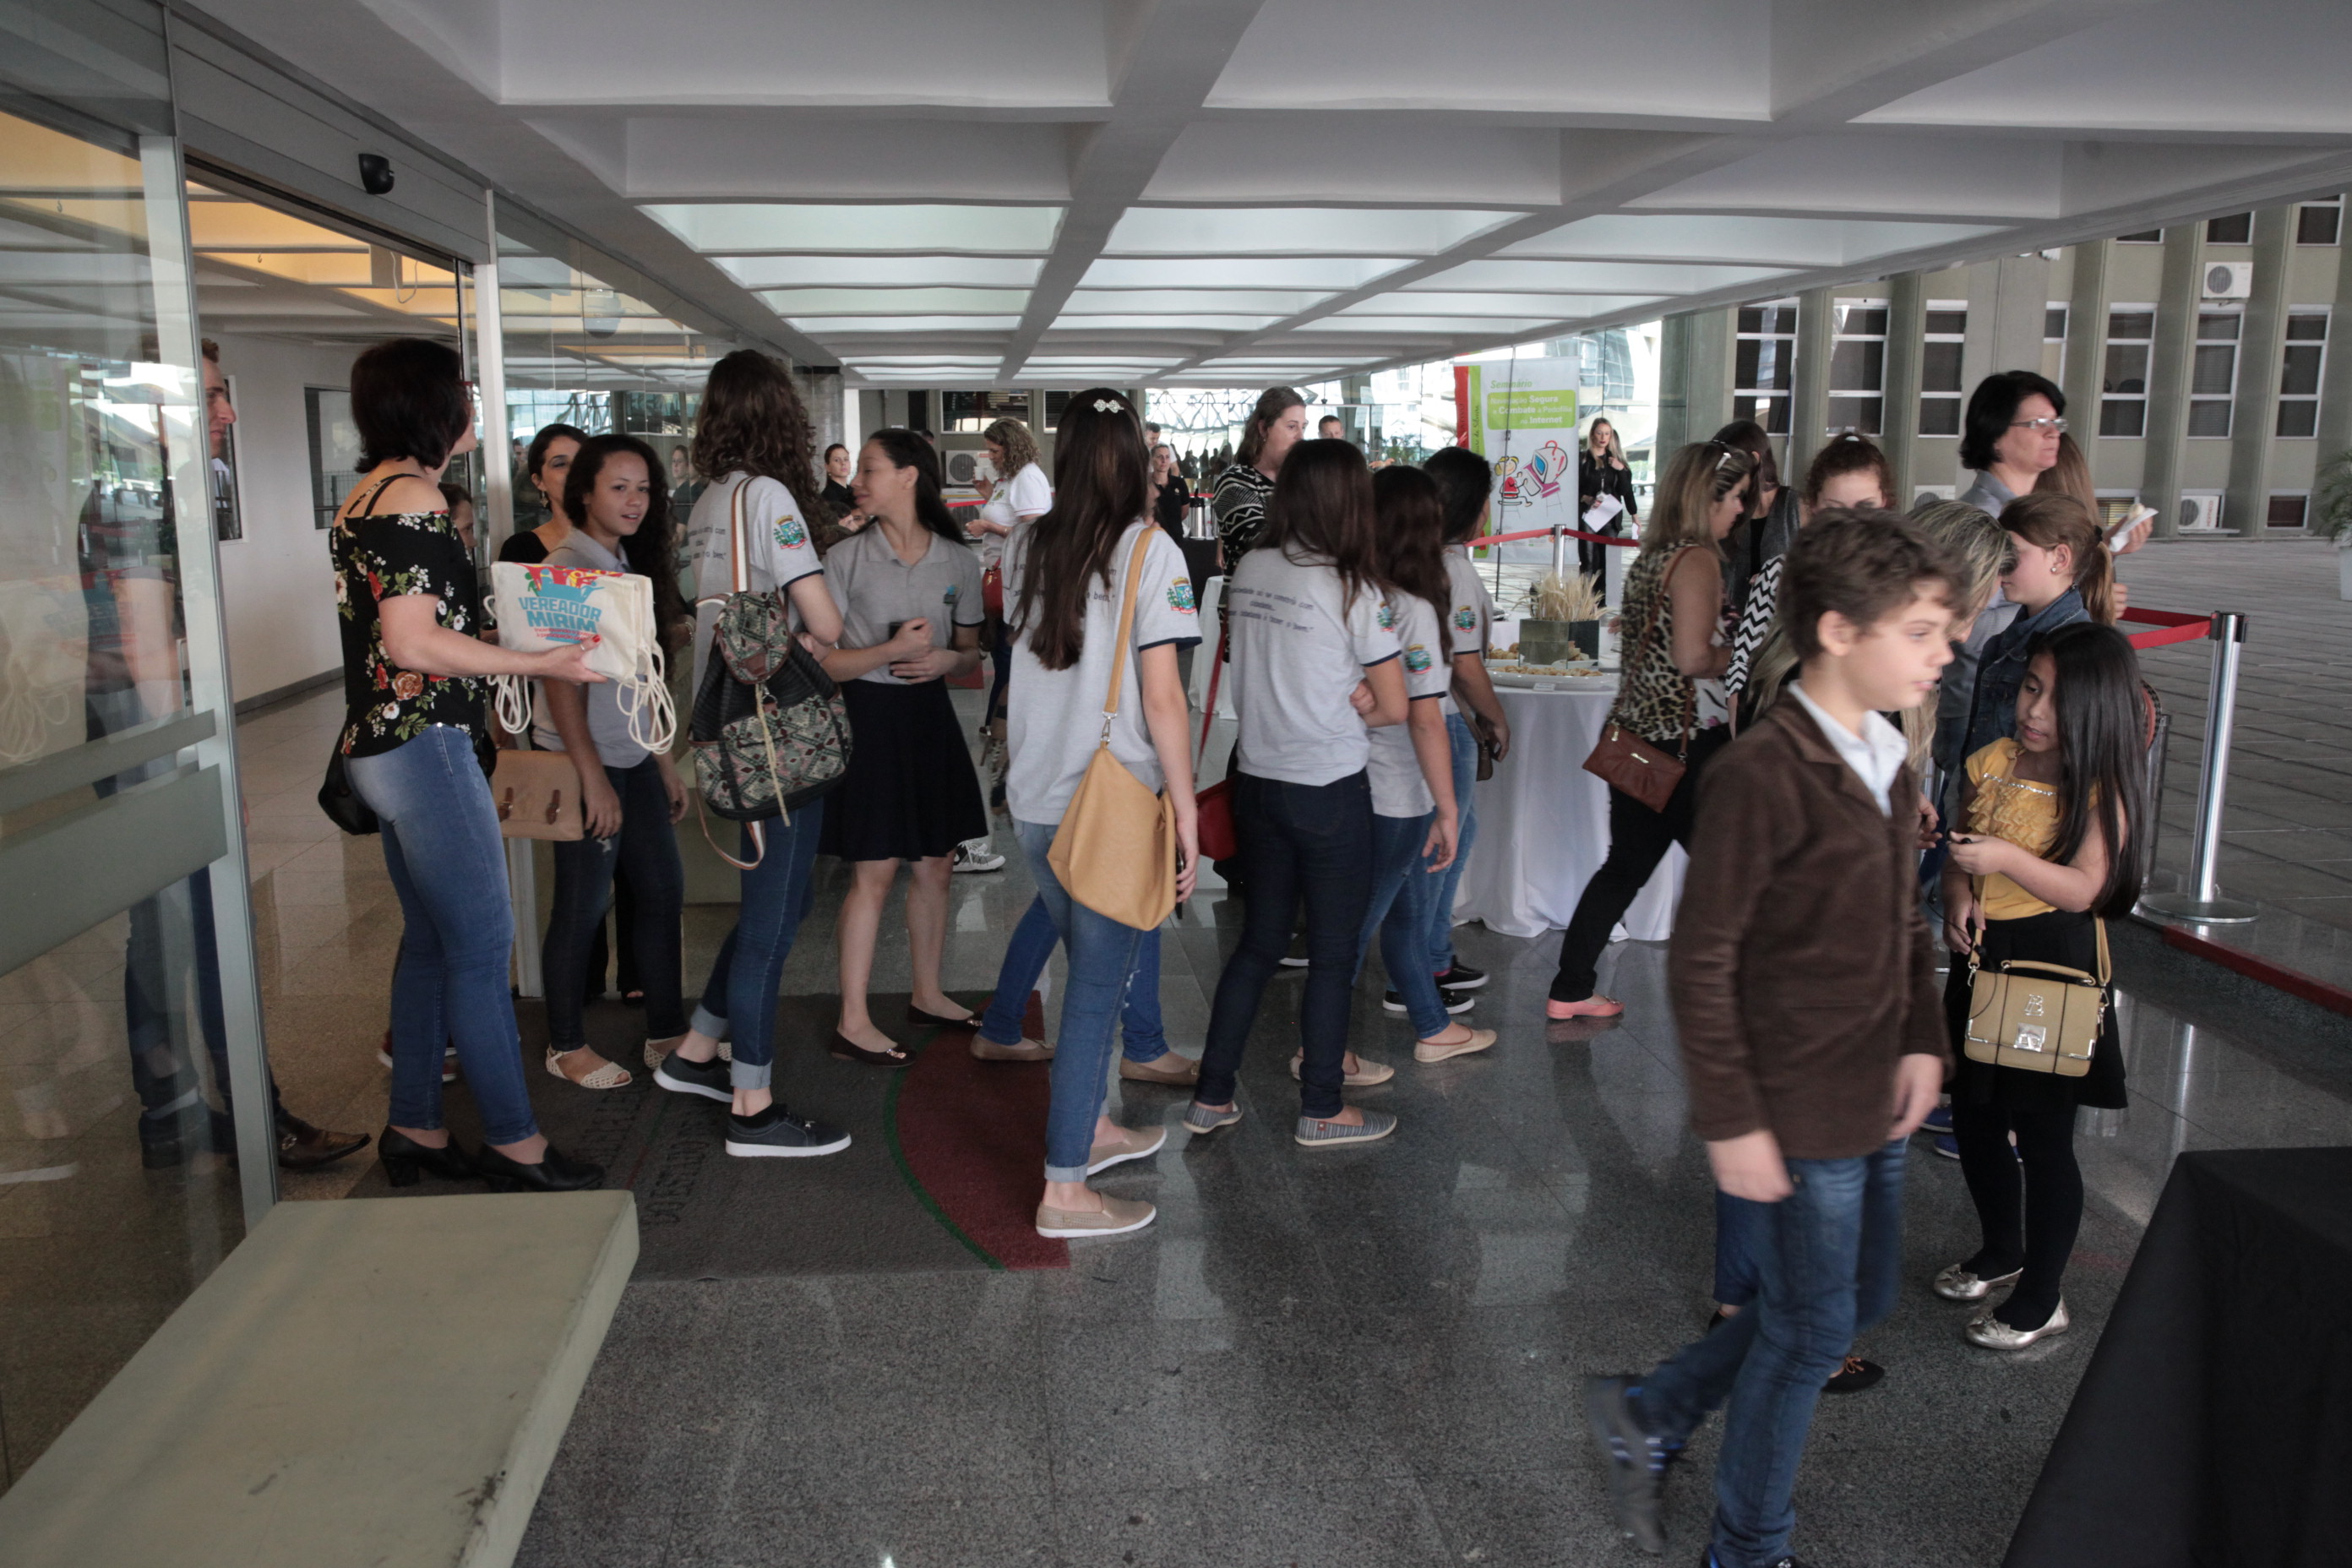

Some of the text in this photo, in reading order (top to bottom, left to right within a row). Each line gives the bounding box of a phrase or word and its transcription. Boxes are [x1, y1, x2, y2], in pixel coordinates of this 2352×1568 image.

[1490, 379, 1533, 389] Semnário
[1529, 395, 1559, 404] Segura
[518, 596, 602, 622] VEREADOR
[526, 611, 597, 634] MIRIM
